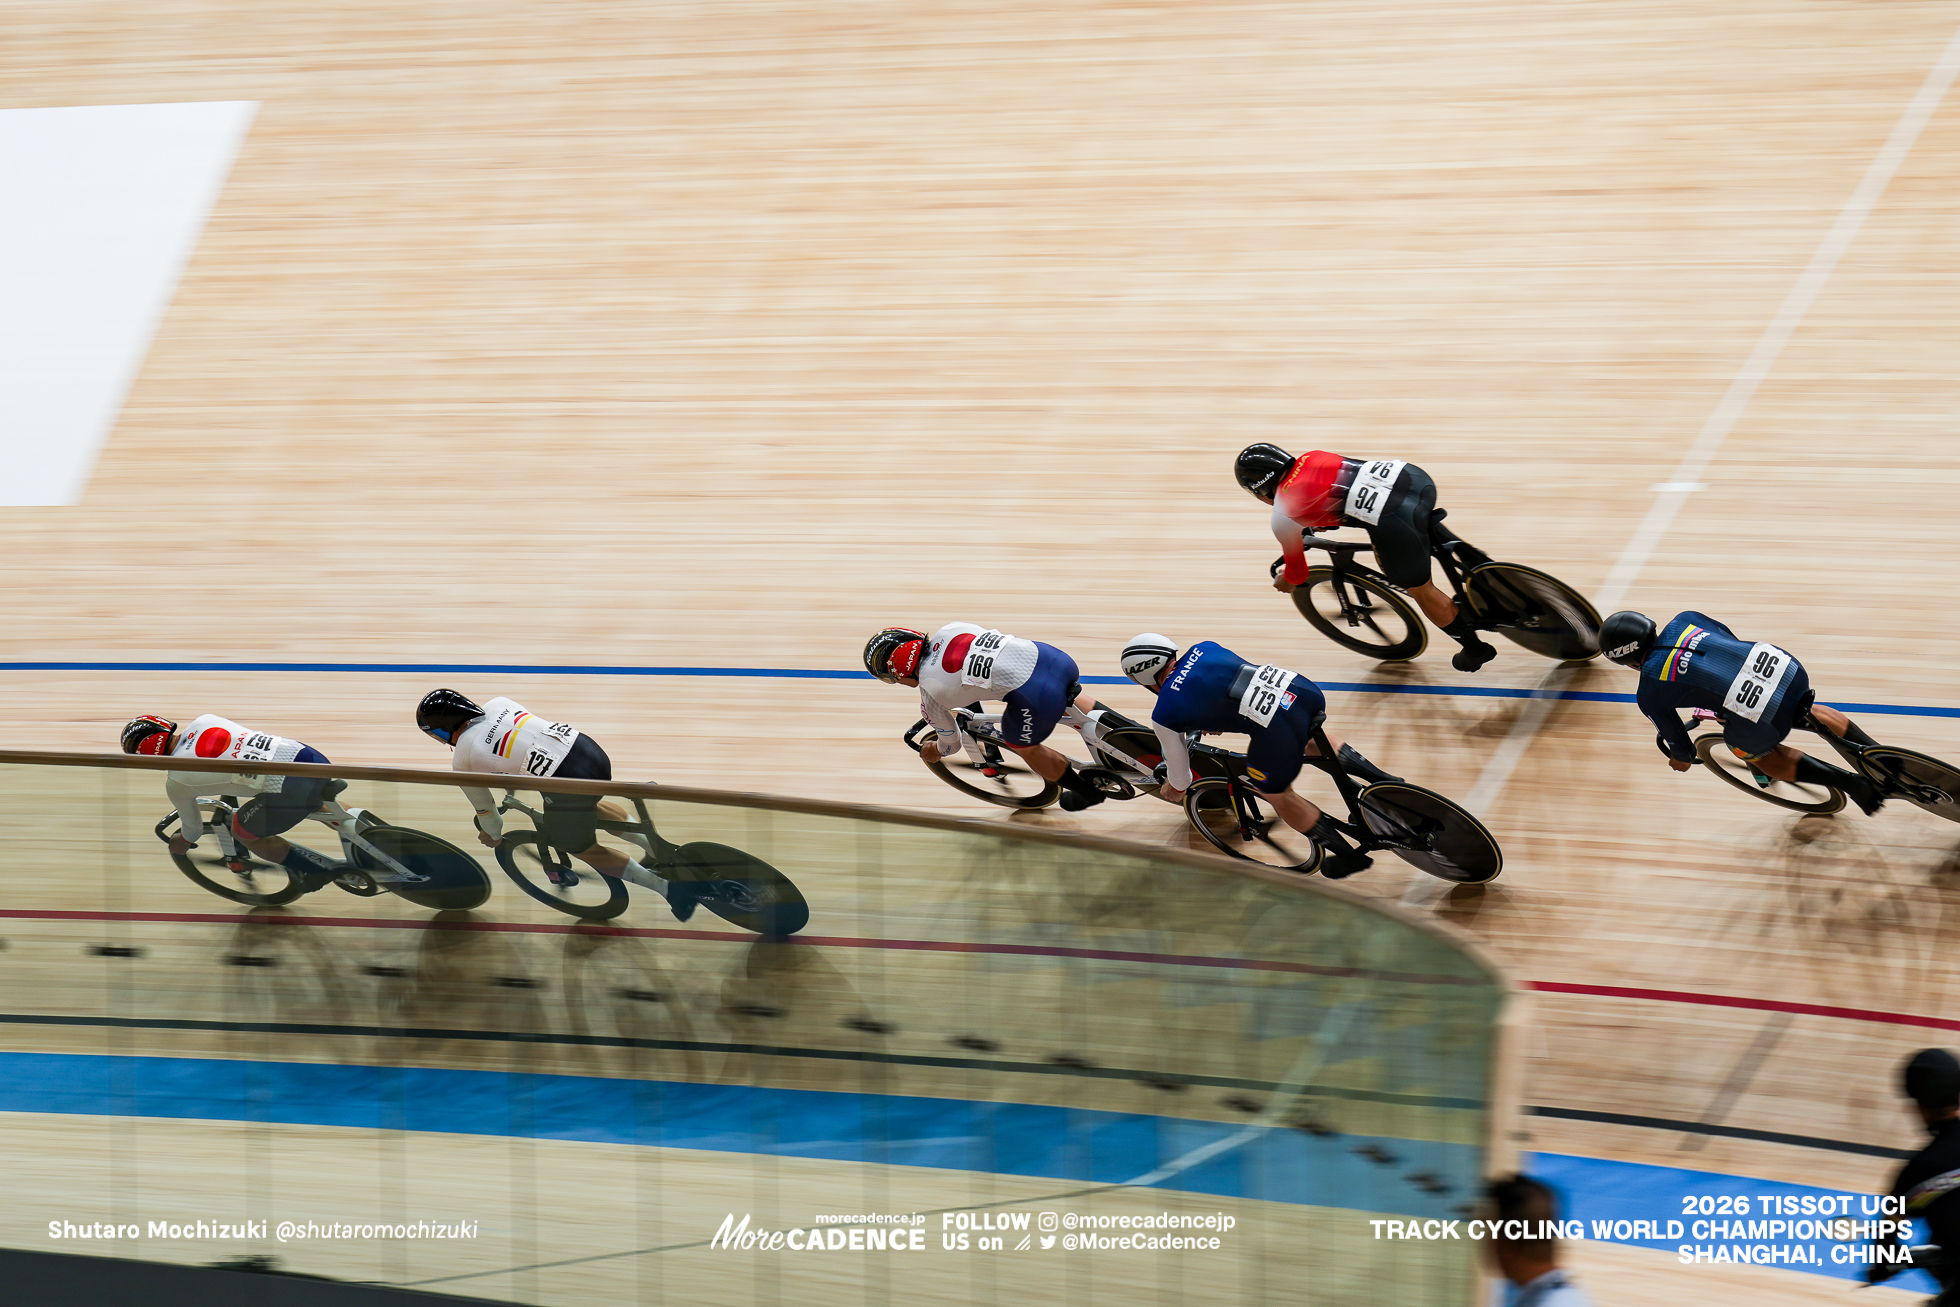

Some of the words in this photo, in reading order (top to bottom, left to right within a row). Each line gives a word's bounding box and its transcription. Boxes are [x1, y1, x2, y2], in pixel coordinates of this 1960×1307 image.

[1281, 453, 1310, 494] CHINA
[1355, 486, 1379, 513] 94
[974, 631, 1006, 651] 168
[1603, 641, 1640, 659] LAZER
[906, 642, 918, 671] JAPAN
[966, 653, 994, 680] 168
[1125, 656, 1161, 676] LAZER
[1170, 647, 1204, 692] FRANCE
[1752, 650, 1780, 678] 96
[1248, 686, 1277, 716] 113
[1735, 679, 1765, 709] 96
[485, 708, 511, 744] GERMANY
[1019, 708, 1033, 744] JAPAN
[246, 733, 273, 751] 167
[527, 750, 554, 776] 127
